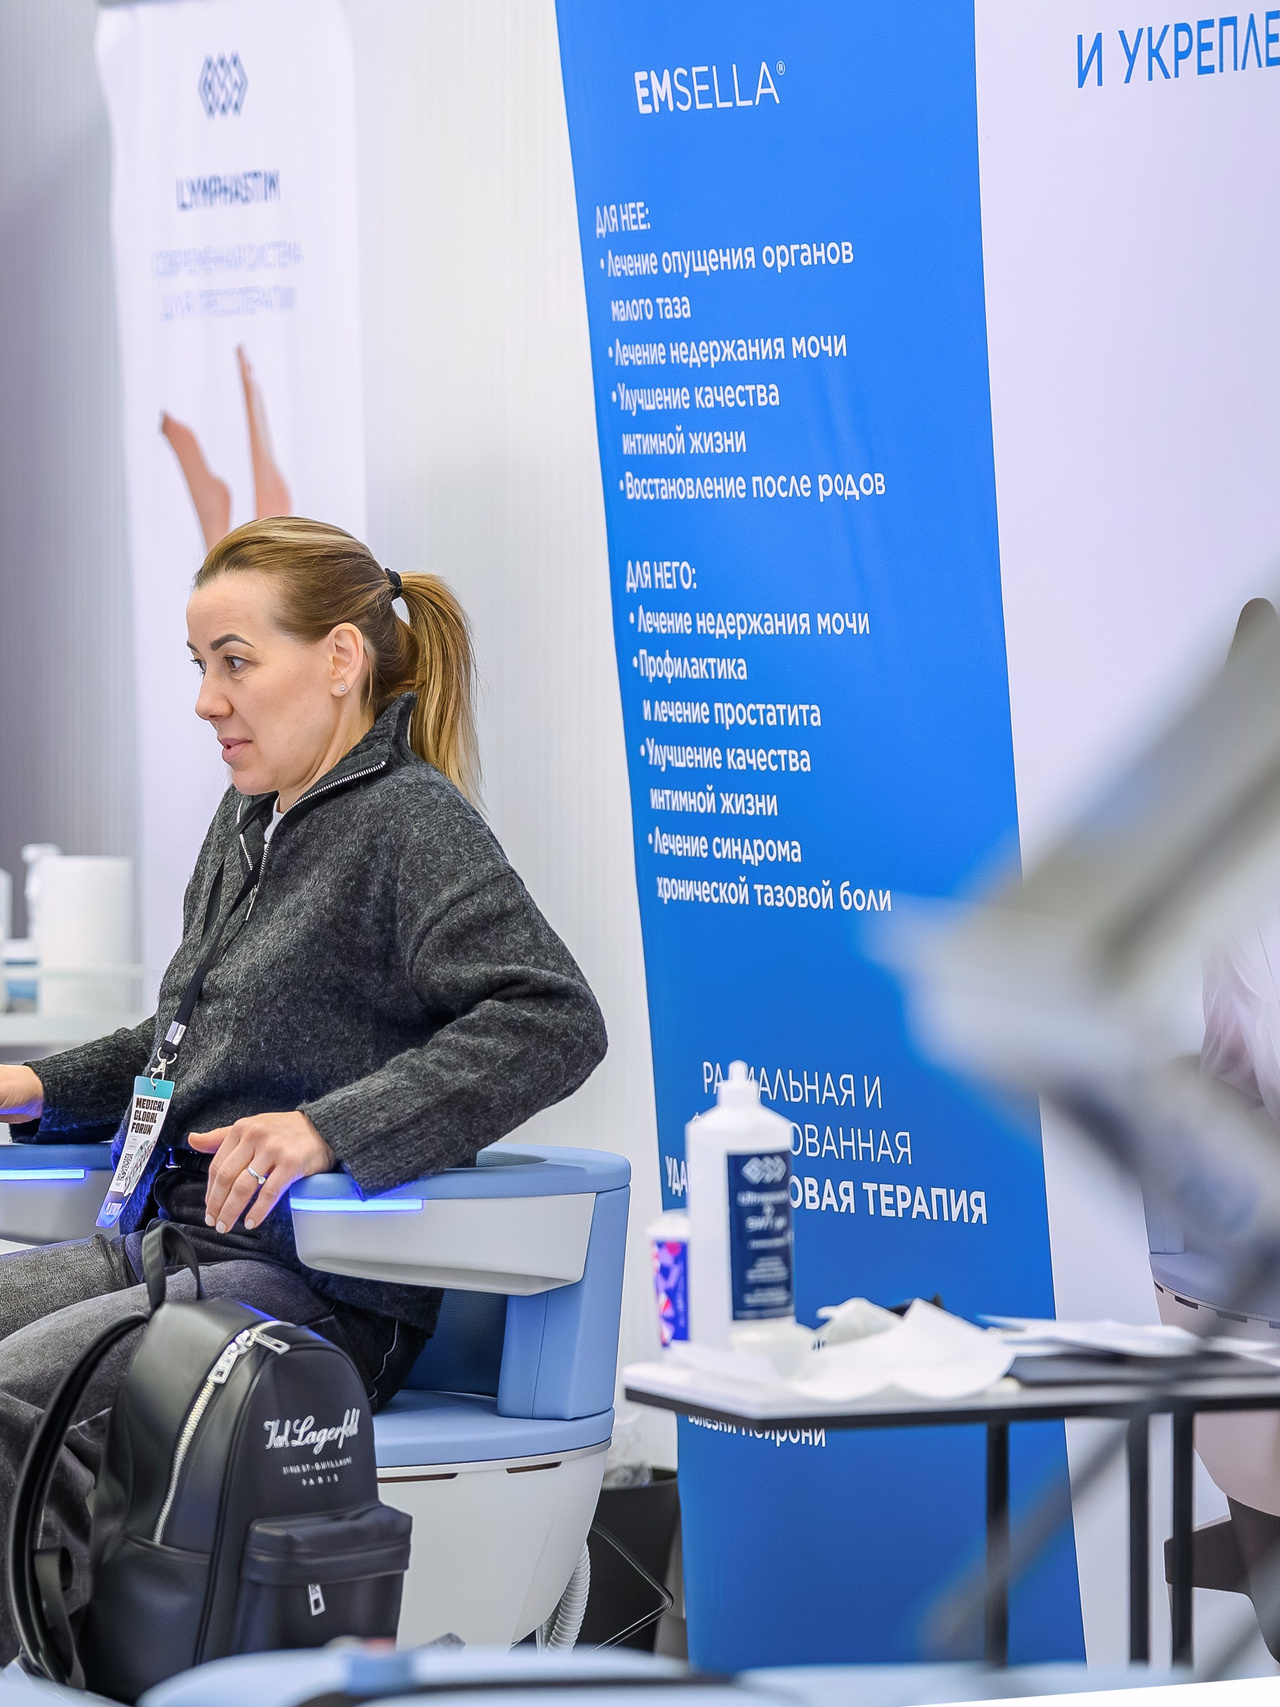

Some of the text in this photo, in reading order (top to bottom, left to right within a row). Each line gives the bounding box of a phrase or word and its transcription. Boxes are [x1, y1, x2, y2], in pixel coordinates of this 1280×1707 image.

[1077, 10, 1280, 88] И УКРЕПЛЕ
[596, 202, 650, 238] ДЛЯ НЕЕ:
[608, 242, 853, 278] Лечение опущения органов
[611, 297, 691, 321] малого таза
[616, 335, 846, 368] Лечение недержания мочи
[618, 383, 779, 416] Улучшение качества
[623, 425, 746, 454] интимной жизни
[626, 472, 885, 502] Восстановление после родов
[626, 560, 696, 592] ДЛЯ НЕГО:
[638, 605, 869, 640] Лечение недержания мочи
[640, 649, 747, 683] Профилактика
[643, 699, 821, 730] и лечение простатита
[647, 738, 810, 771] Улучшение качества
[651, 785, 777, 815] интимной жизни
[655, 827, 801, 866] Лечение синдрома
[657, 876, 891, 911] хронической тазовой боли
[135, 1098, 164, 1111] MEDICAL
[864, 1075, 882, 1109] И
[131, 1123, 153, 1135] FORUM
[133, 1111, 157, 1123] GLOBAL
[862, 1182, 988, 1225] ТЕРАПИЯ
